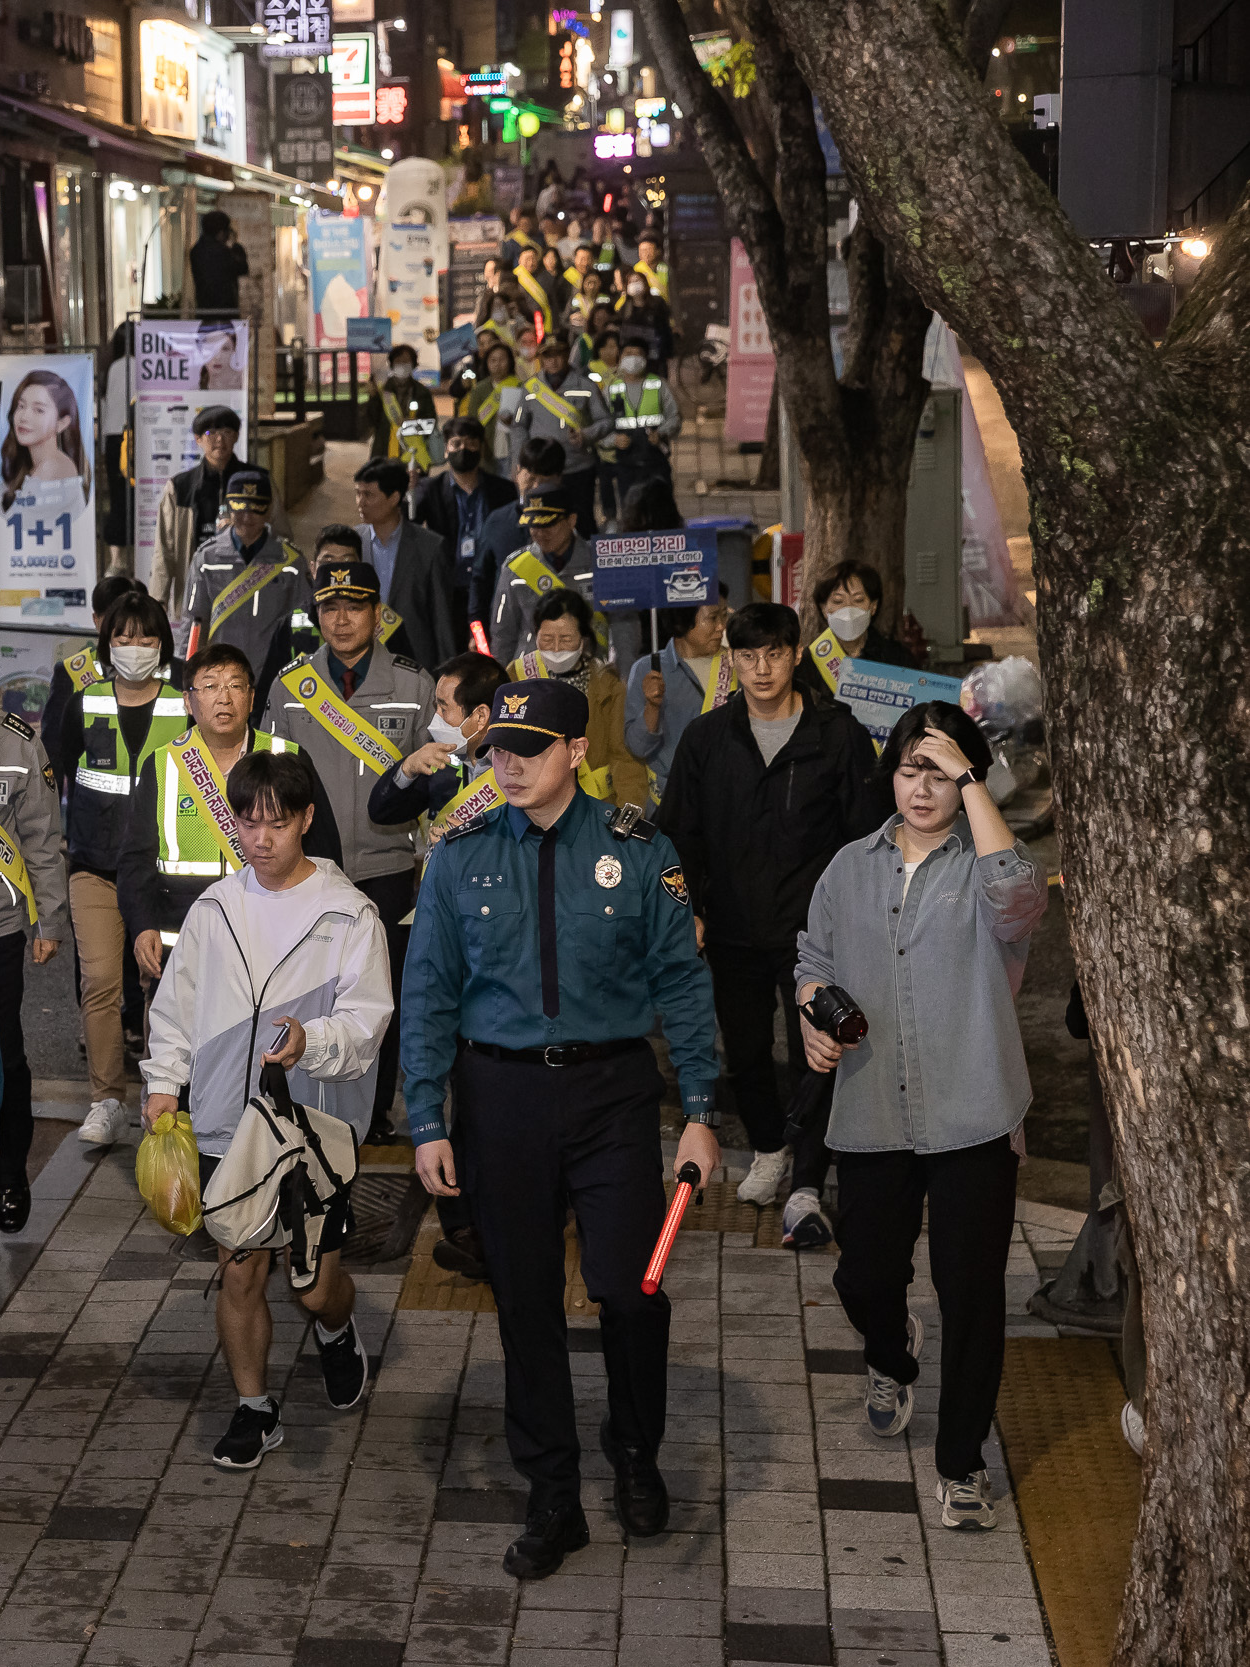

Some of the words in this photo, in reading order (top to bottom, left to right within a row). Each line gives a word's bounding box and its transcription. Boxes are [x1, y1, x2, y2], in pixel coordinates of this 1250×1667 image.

[141, 359, 190, 380] SALE
[6, 512, 72, 550] 1+1
[596, 537, 651, 556] 건대맛의
